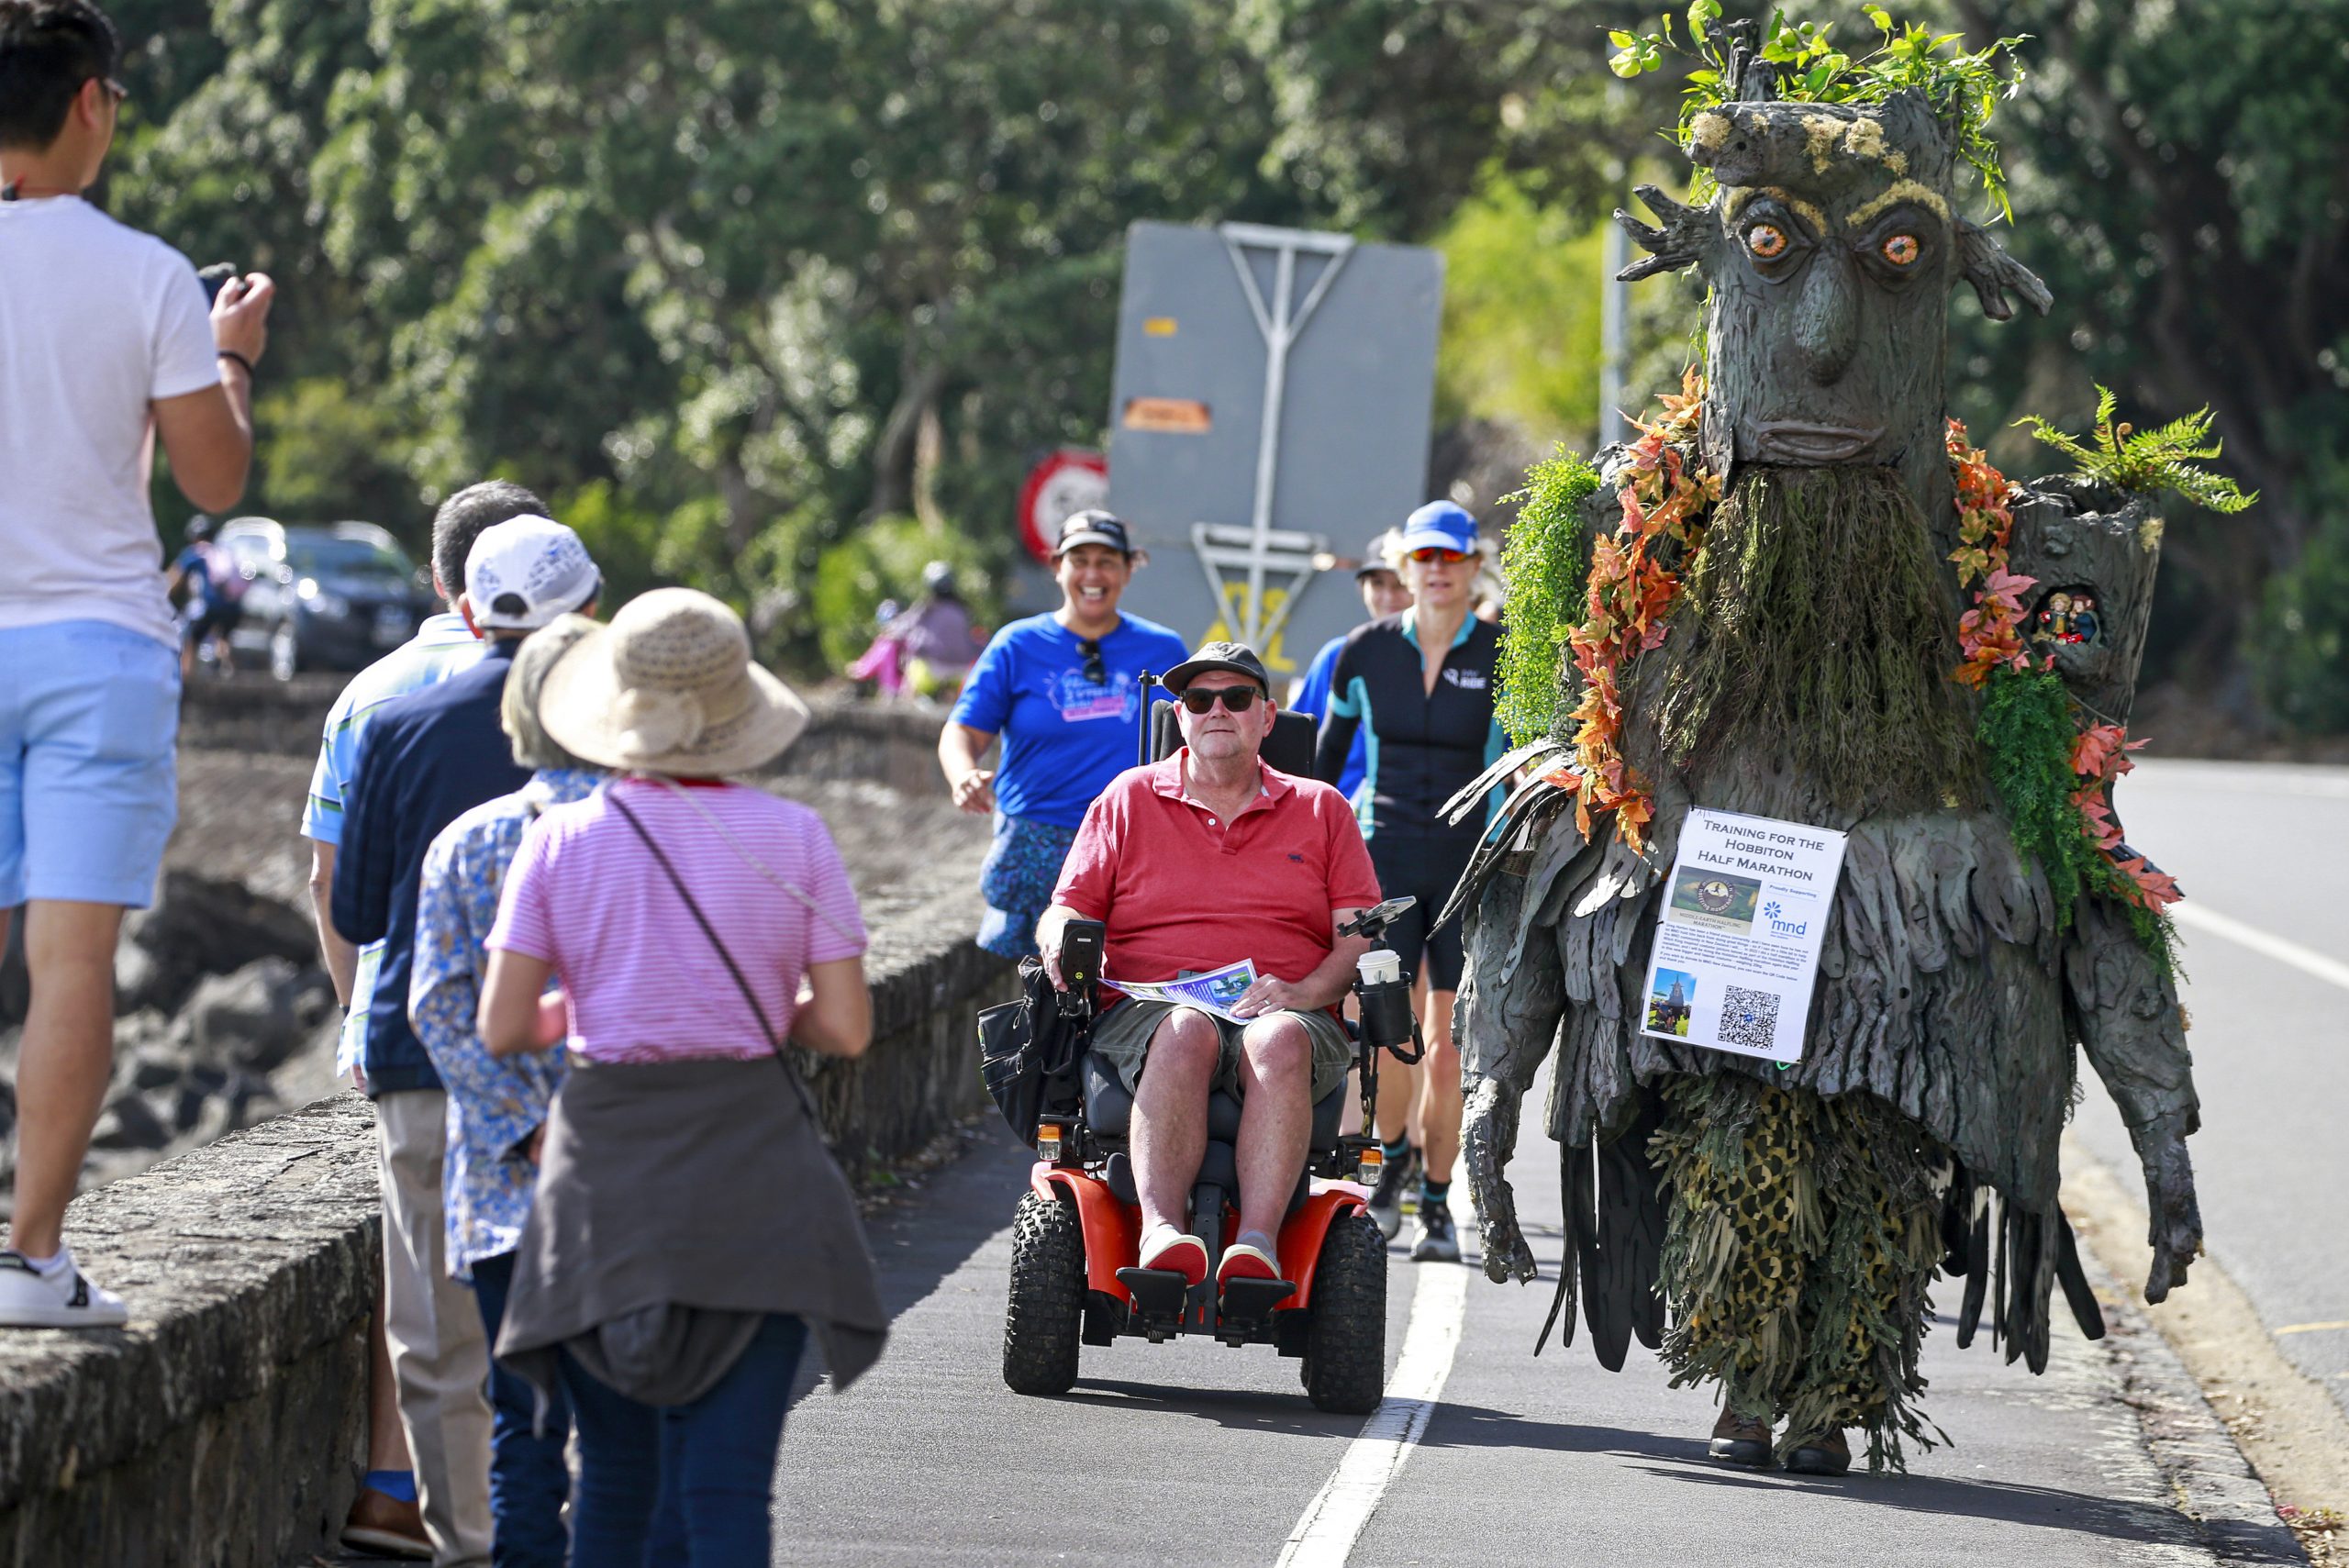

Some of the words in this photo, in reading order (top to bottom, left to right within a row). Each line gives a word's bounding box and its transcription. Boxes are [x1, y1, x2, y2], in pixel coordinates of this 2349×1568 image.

[1704, 819, 1766, 840] TRAINING
[1769, 833, 1796, 845] FOR
[1798, 839, 1824, 851] THE
[1725, 839, 1794, 861] HOBBITON
[1698, 851, 1734, 865] HALF
[1737, 858, 1813, 881] MARATHON
[1772, 920, 1807, 935] mnd
